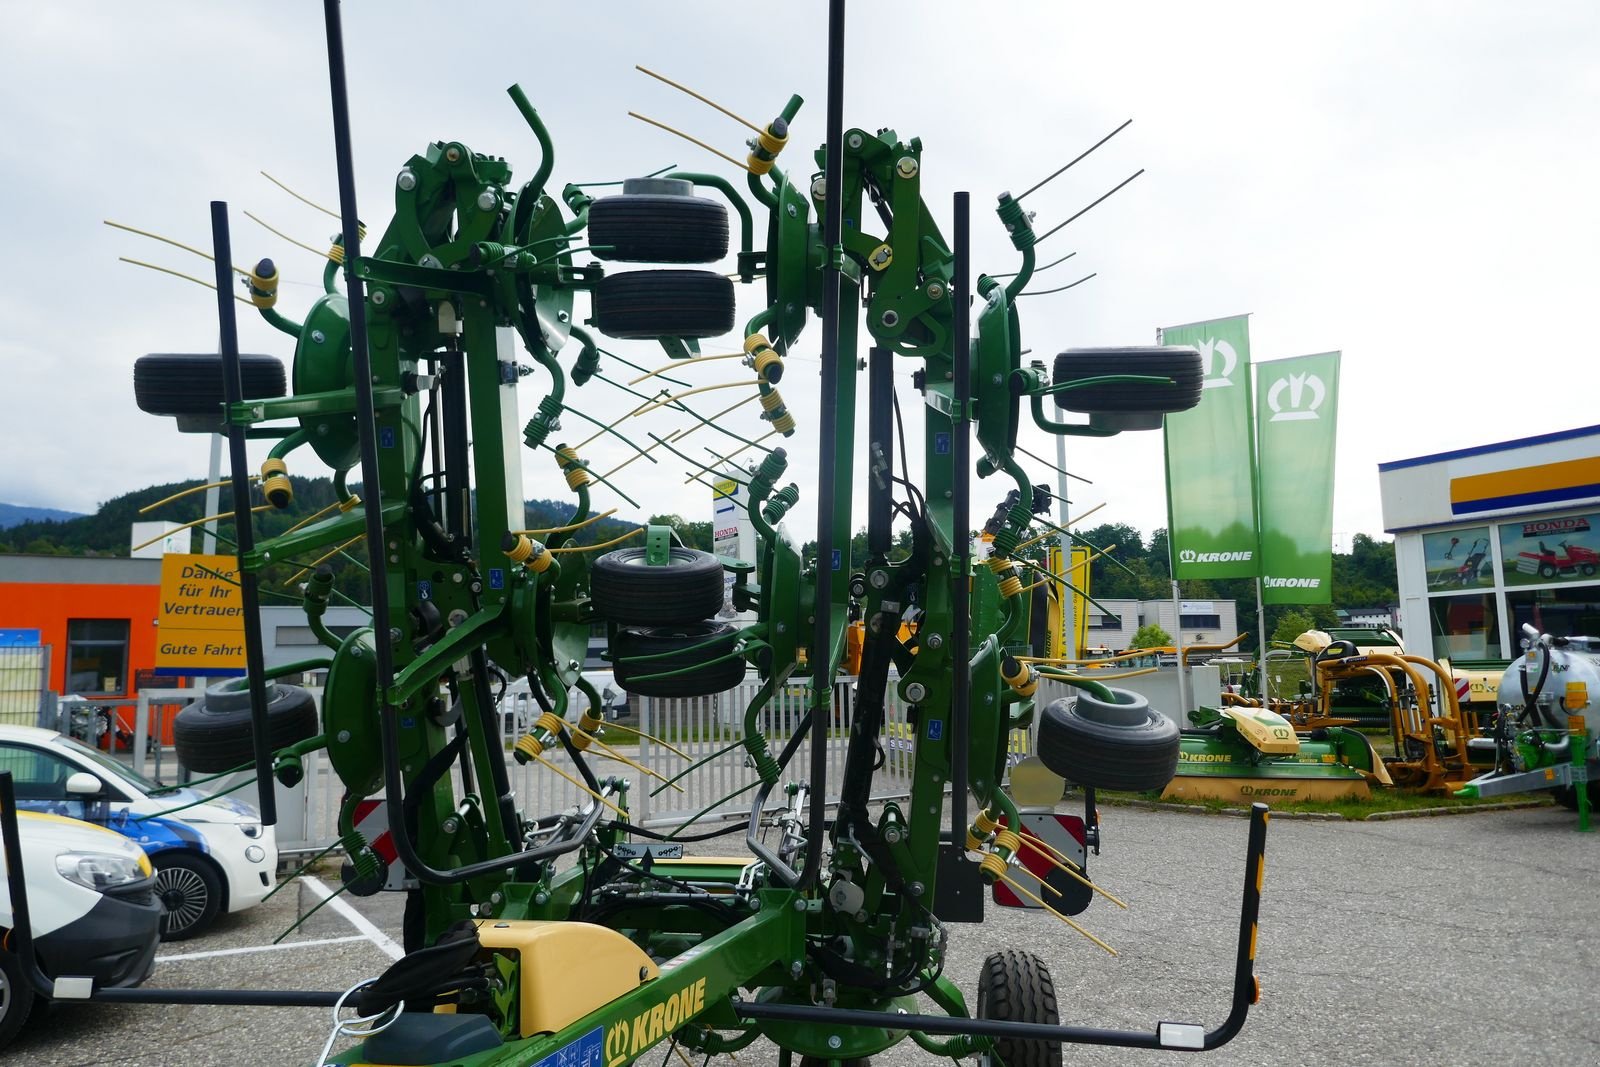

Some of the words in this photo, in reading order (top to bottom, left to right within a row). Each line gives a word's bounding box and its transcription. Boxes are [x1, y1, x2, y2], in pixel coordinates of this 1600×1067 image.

[1523, 517, 1590, 533] HONDA
[715, 526, 738, 538] HONDA
[1197, 551, 1252, 562] KRONE
[181, 566, 234, 580] Danke
[1269, 577, 1320, 588] KRONE
[179, 584, 203, 597] für
[209, 586, 232, 598] Ihr
[160, 643, 197, 655] Gute
[204, 644, 243, 656] Fahrt
[1189, 754, 1231, 762] KRONE
[1254, 788, 1297, 797] KRONE
[631, 976, 706, 1056] KRONE
